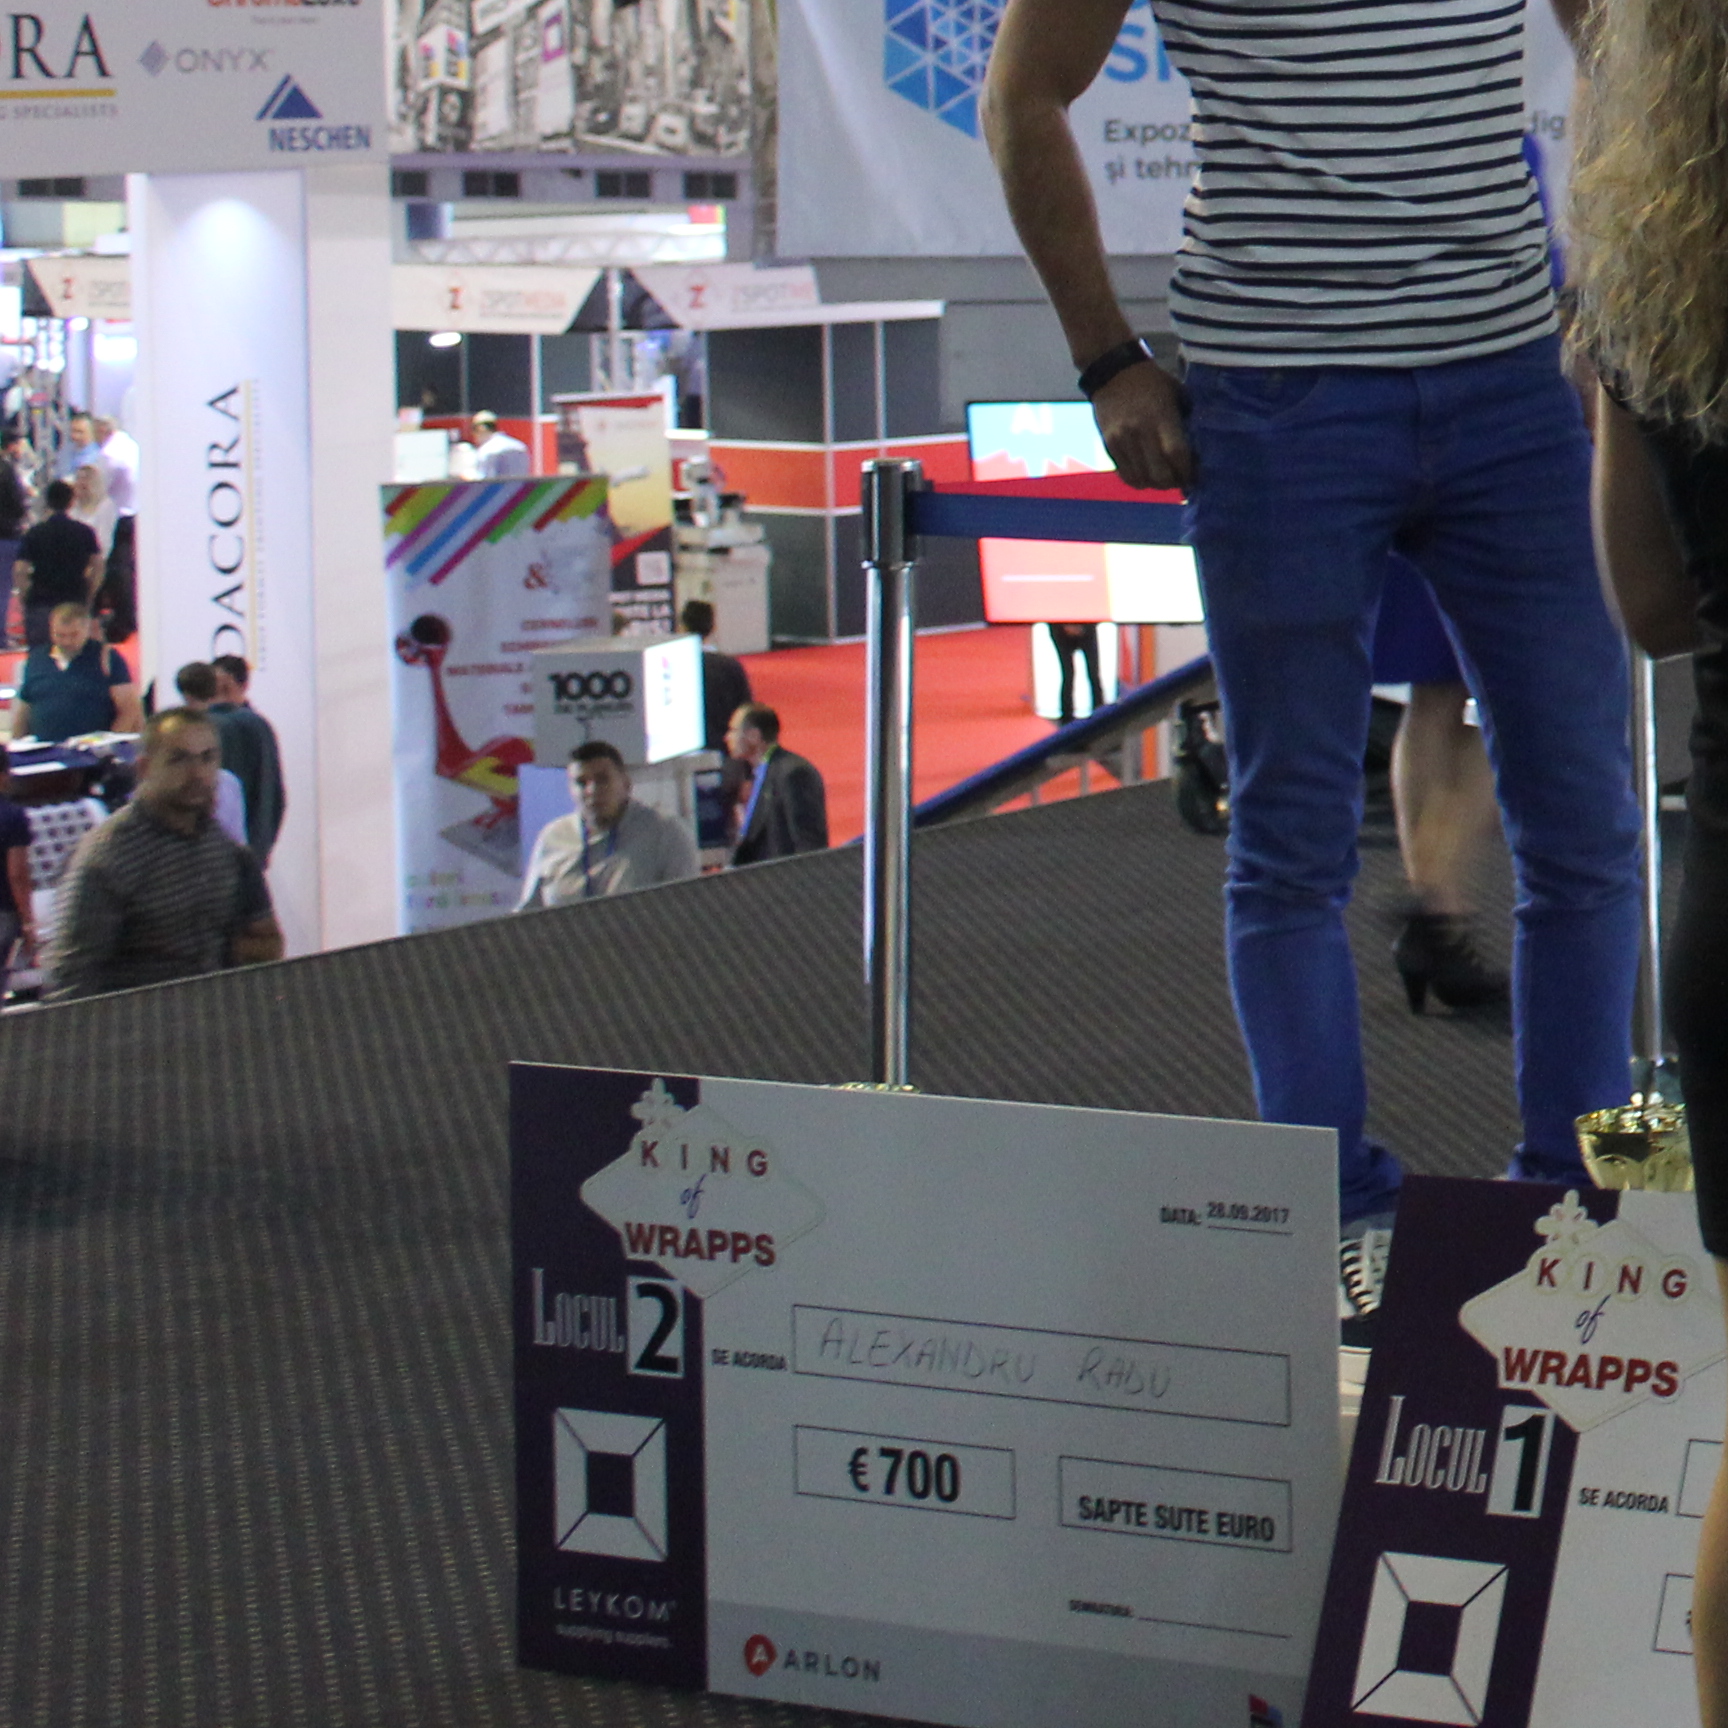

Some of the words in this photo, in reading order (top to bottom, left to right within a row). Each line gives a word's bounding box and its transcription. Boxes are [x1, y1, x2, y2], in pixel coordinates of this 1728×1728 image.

[0, 12, 112, 80] RA
[174, 47, 268, 74] ONYX
[268, 126, 373, 153] NESCHEN
[1104, 120, 1191, 143] Expoz
[549, 670, 634, 702] 1000
[641, 1139, 769, 1177] KING
[680, 1174, 708, 1219] of
[625, 1222, 776, 1267] WRAPPS
[1537, 1258, 1688, 1299] KING
[634, 1282, 681, 1374] 2
[1574, 1294, 1612, 1344] of
[819, 1317, 1036, 1383] ALEXANDRU
[1502, 1346, 1680, 1397] WRAPPS
[1504, 1414, 1547, 1512] 1
[1077, 1495, 1148, 1529] SAPTE
[1154, 1503, 1209, 1536] SUTE
[1216, 1511, 1275, 1543] EURO
[1579, 1487, 1601, 1506] SE
[1604, 1490, 1669, 1514] ACORDA
[783, 1648, 882, 1682] ARLON
